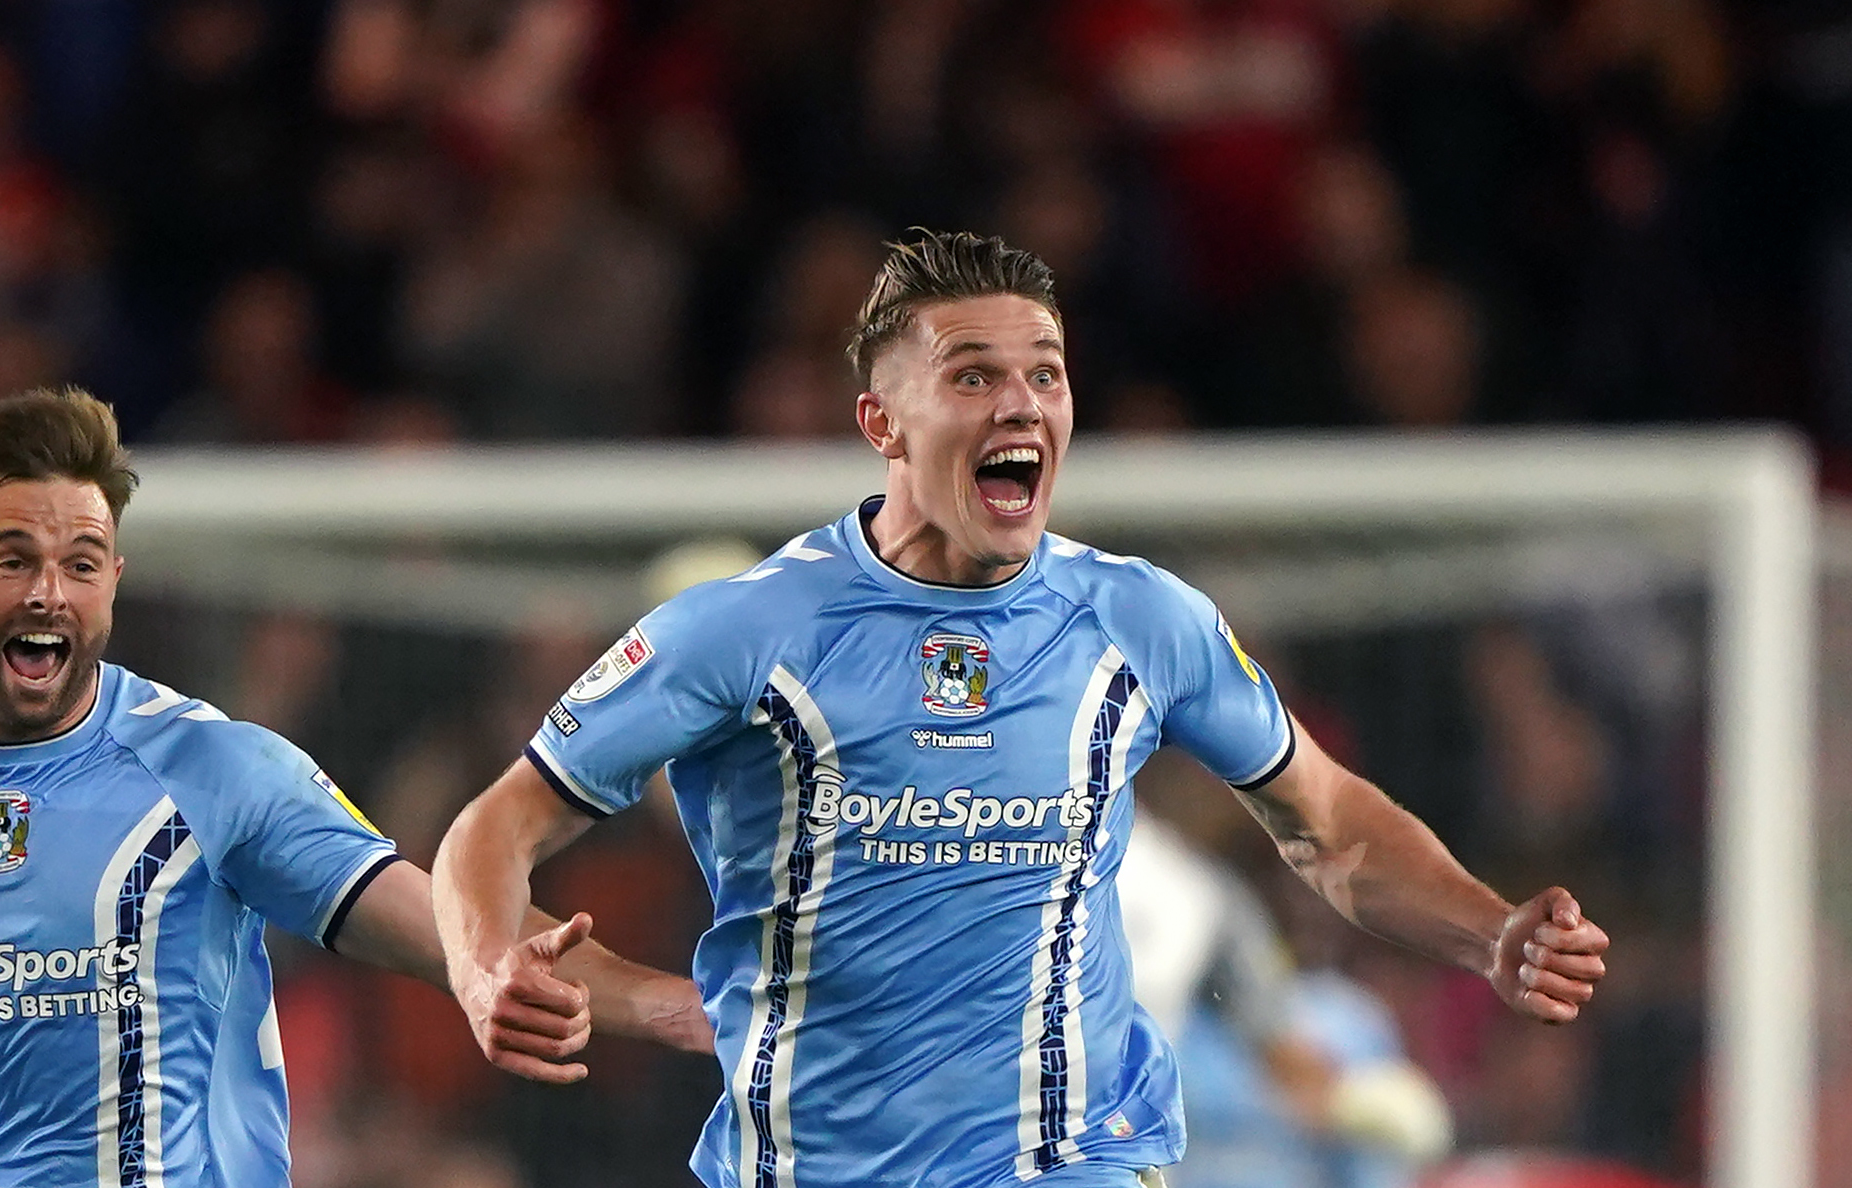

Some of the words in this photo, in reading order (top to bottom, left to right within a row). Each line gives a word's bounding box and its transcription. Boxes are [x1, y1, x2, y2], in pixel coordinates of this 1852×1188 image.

[932, 731, 992, 748] hummel
[809, 781, 1095, 838] BoyleSports
[859, 838, 928, 865] THIS
[934, 840, 962, 865] IS
